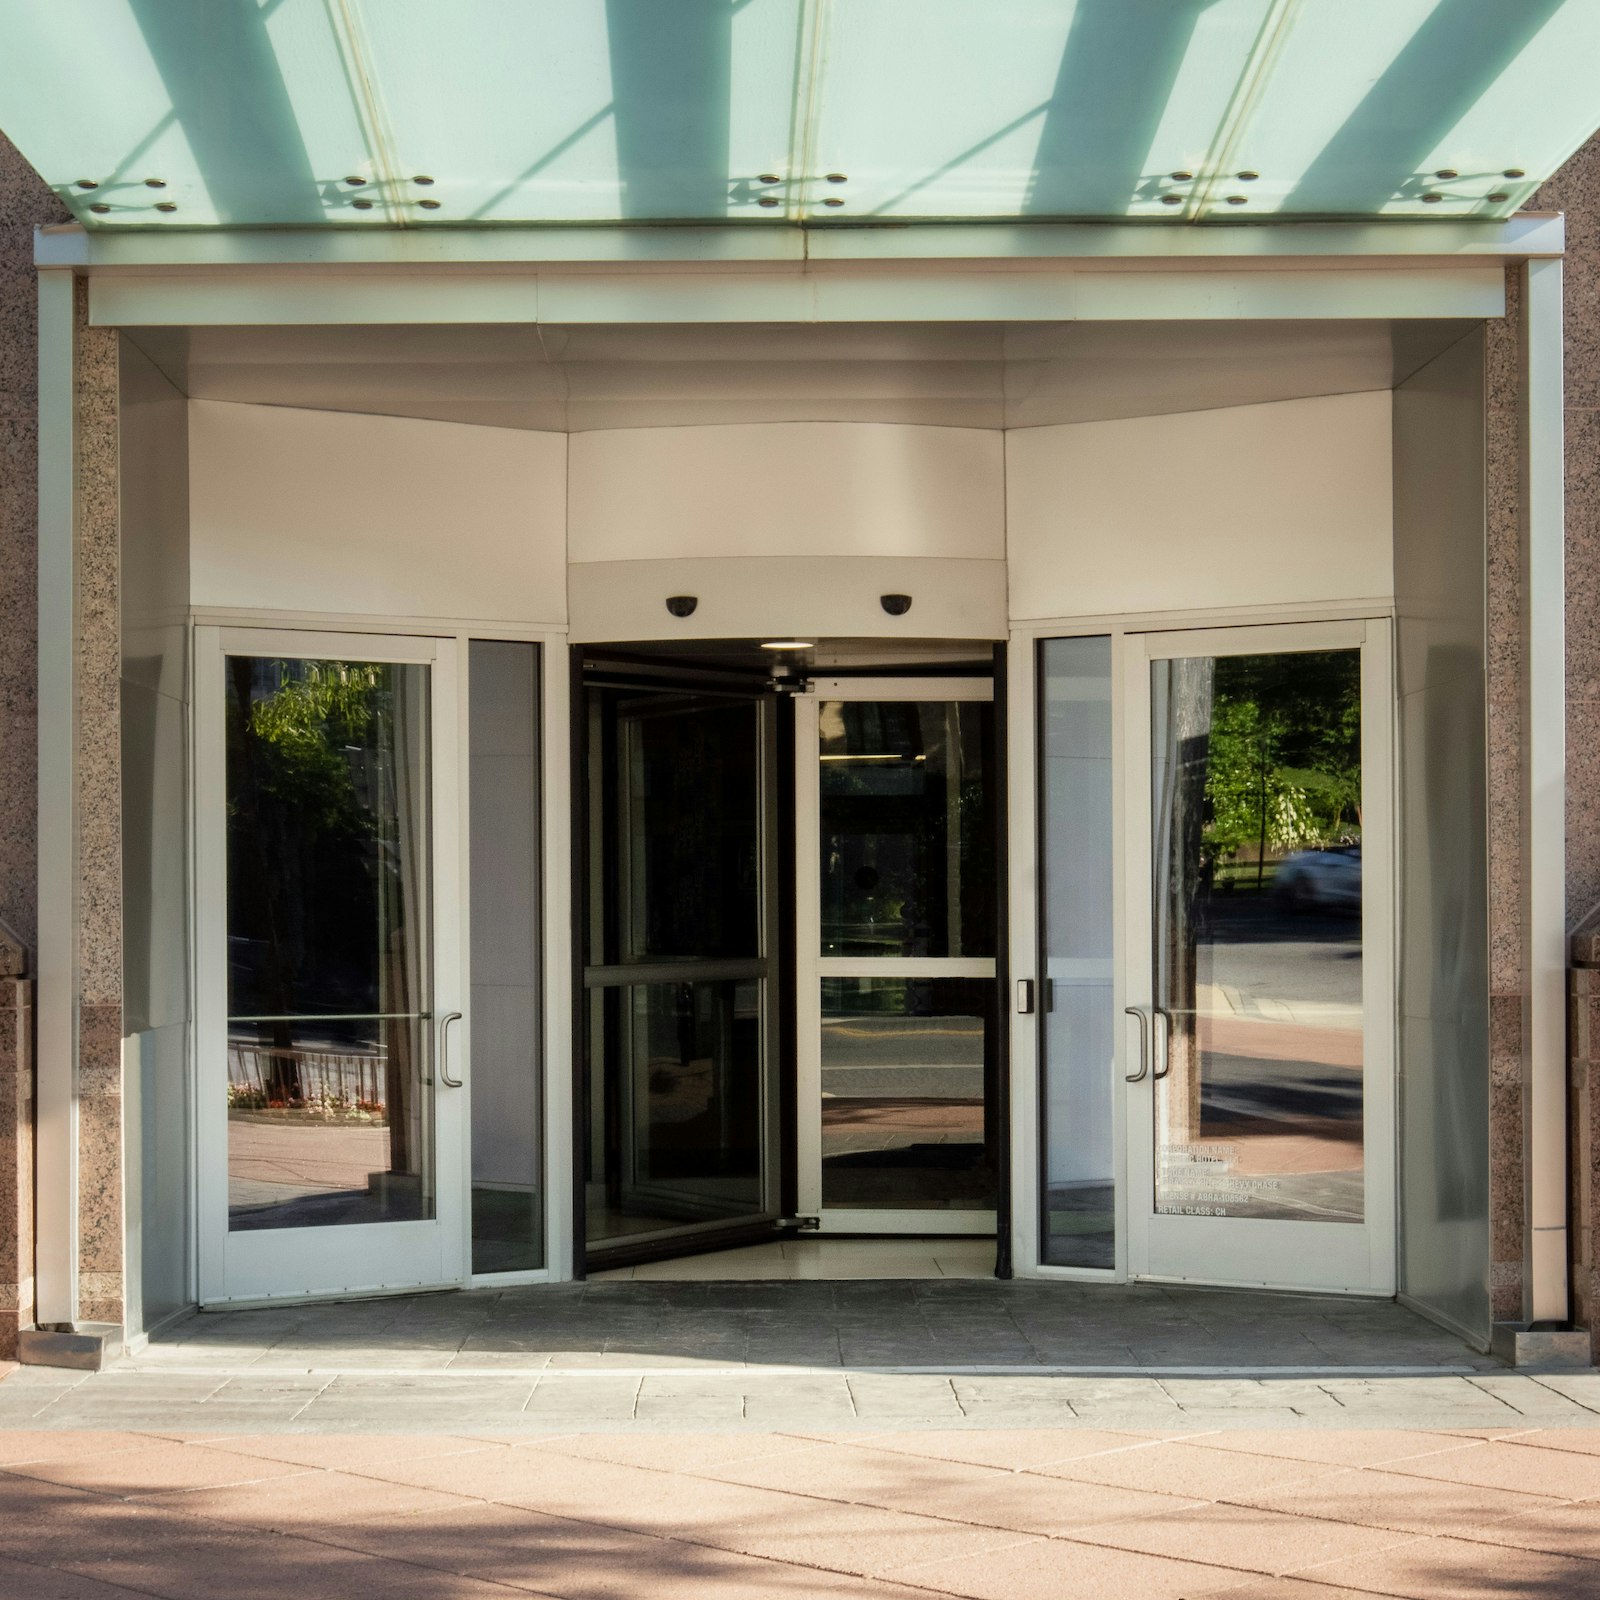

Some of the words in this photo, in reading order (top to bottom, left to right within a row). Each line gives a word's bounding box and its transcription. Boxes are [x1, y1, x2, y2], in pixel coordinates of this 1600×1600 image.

[1224, 1179, 1250, 1189] HEVY
[1158, 1205, 1184, 1214] RETAIL
[1185, 1206, 1214, 1216] CLASS:
[1215, 1207, 1226, 1216] CH
